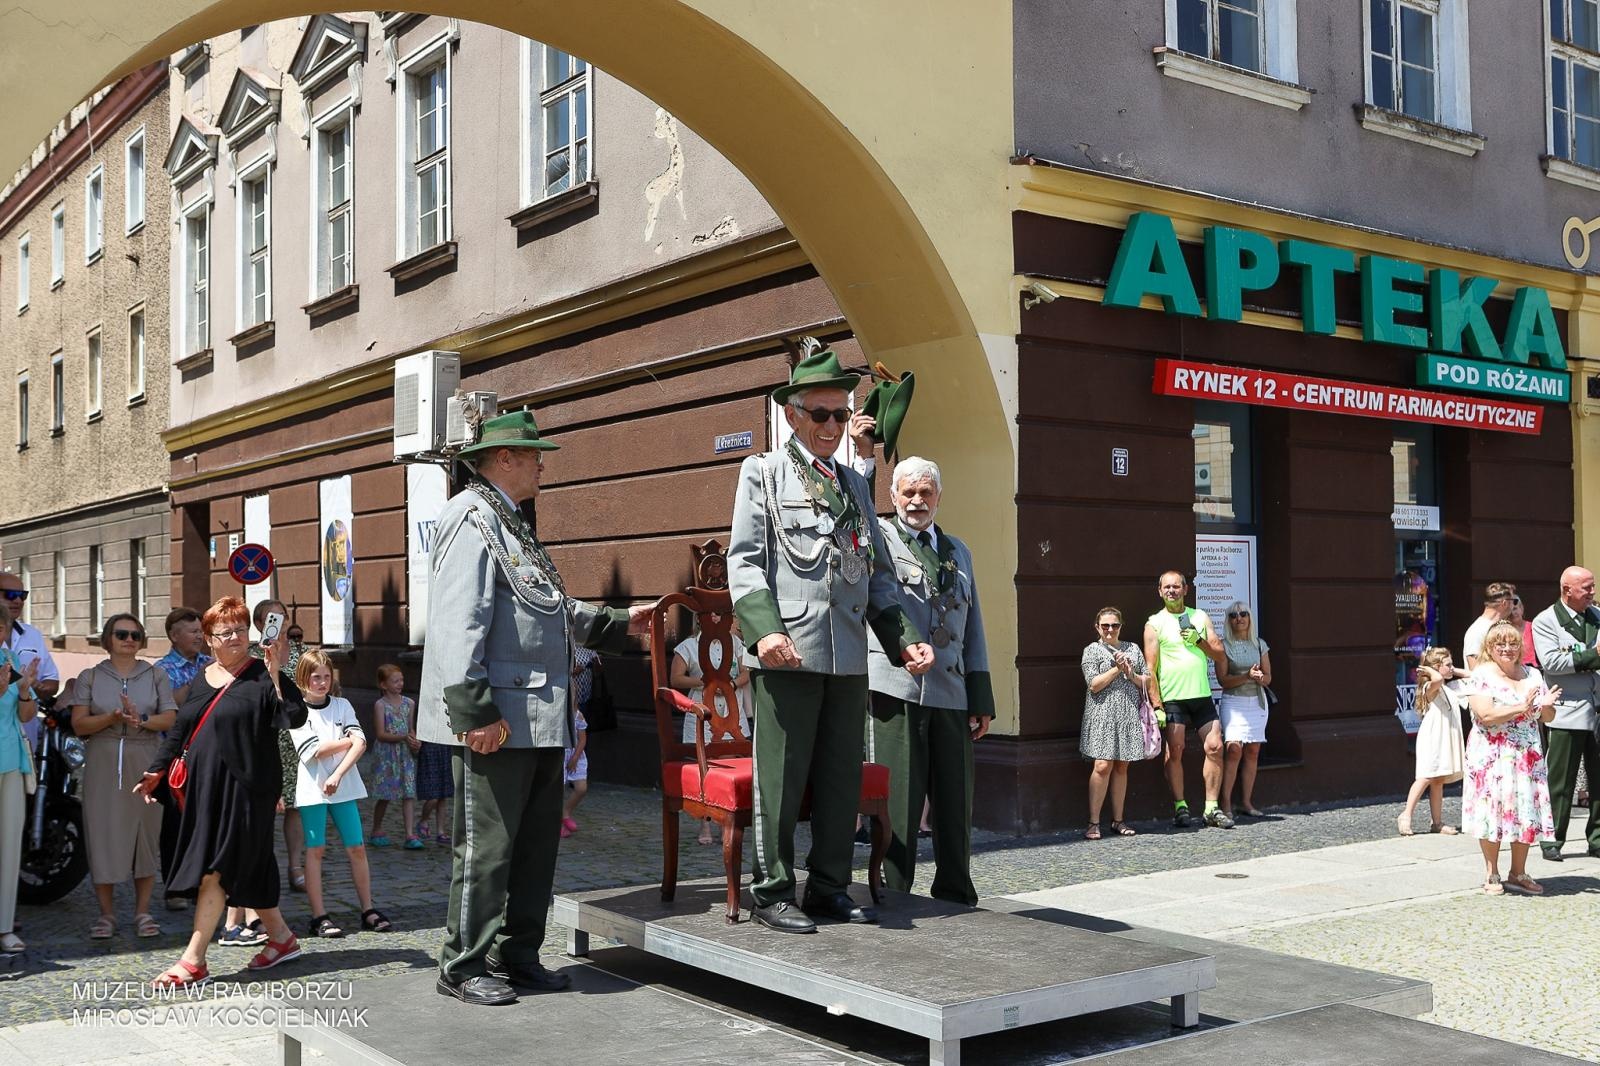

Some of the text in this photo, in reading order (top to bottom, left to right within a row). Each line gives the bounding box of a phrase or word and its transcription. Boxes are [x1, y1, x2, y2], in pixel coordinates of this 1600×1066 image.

[1102, 211, 1568, 370] APTEKA
[1436, 362, 1563, 397] POD RÓŻAMI
[1174, 367, 1248, 397] RYNEK
[1254, 377, 1277, 400] 12
[1293, 382, 1383, 412] CENTRUM
[1388, 393, 1536, 429] FARMACEUTYCZNE
[1115, 457, 1125, 469] 12
[1392, 516, 1429, 528] vawisla.pl
